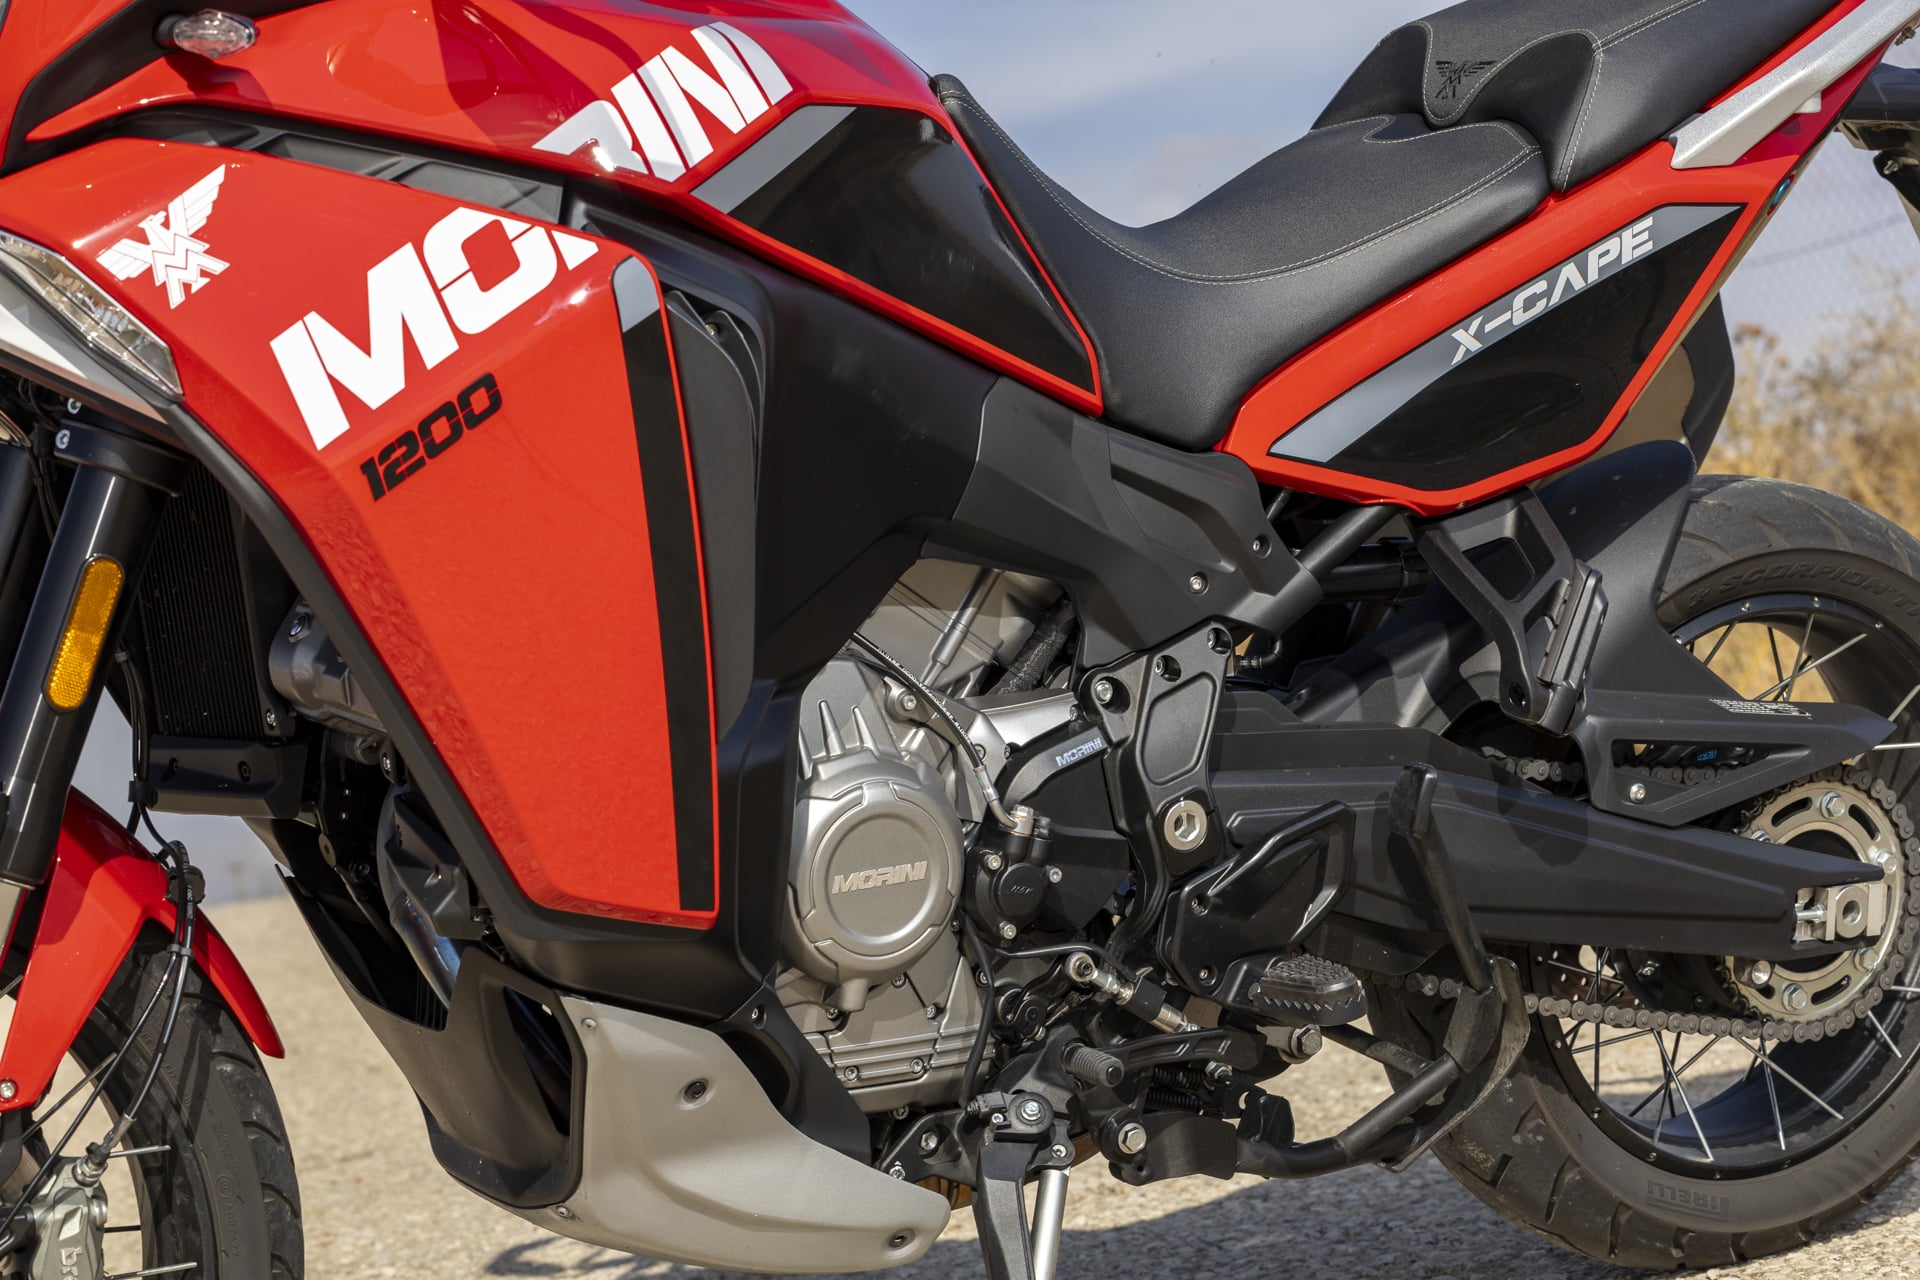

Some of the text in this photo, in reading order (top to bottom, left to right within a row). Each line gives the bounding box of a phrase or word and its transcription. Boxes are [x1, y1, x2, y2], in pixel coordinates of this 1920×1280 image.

[1451, 216, 1654, 366] X-CAPE
[360, 372, 502, 502] 1200
[1055, 737, 1103, 767] MORINI
[831, 860, 928, 895] MORINI
